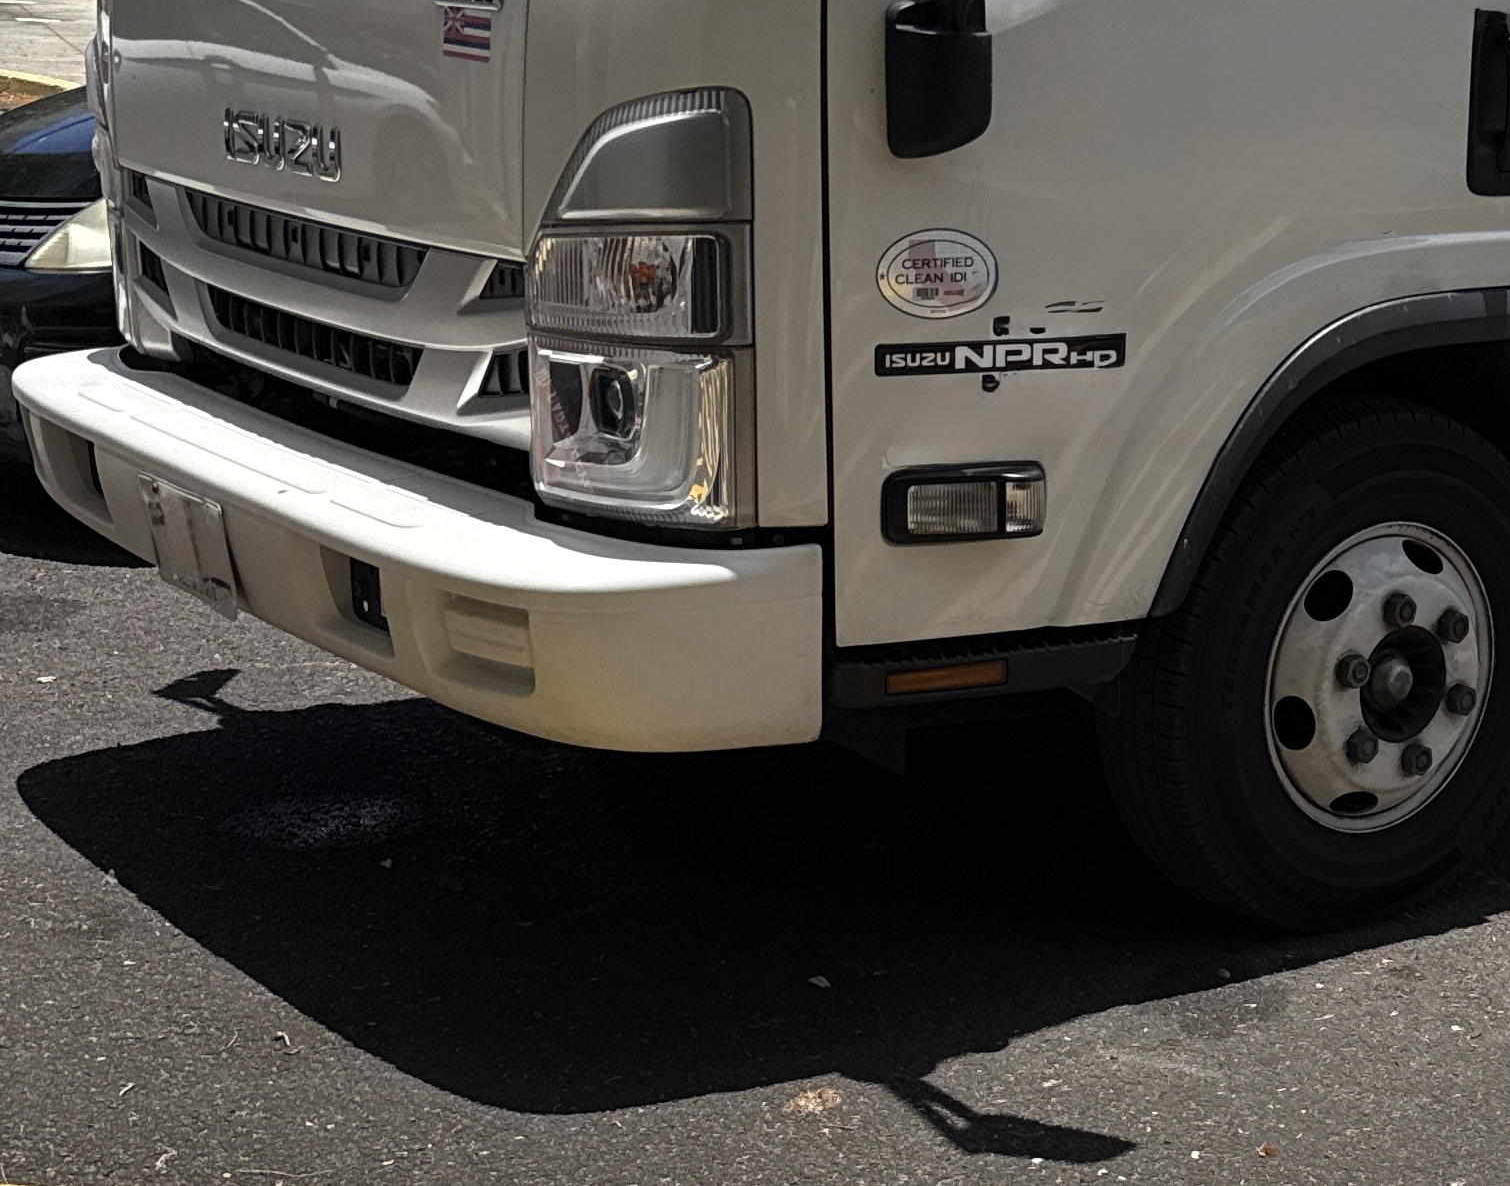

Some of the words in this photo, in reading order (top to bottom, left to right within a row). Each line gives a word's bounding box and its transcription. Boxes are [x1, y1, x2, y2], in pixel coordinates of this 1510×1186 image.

[223, 107, 341, 182] ISUZU
[902, 257, 975, 270] CERTIFIED
[895, 273, 944, 285] CLEAN
[950, 272, 967, 283] IDI
[885, 352, 950, 368] ISUZU
[954, 342, 1068, 370] NPR
[1069, 349, 1118, 370] HD
